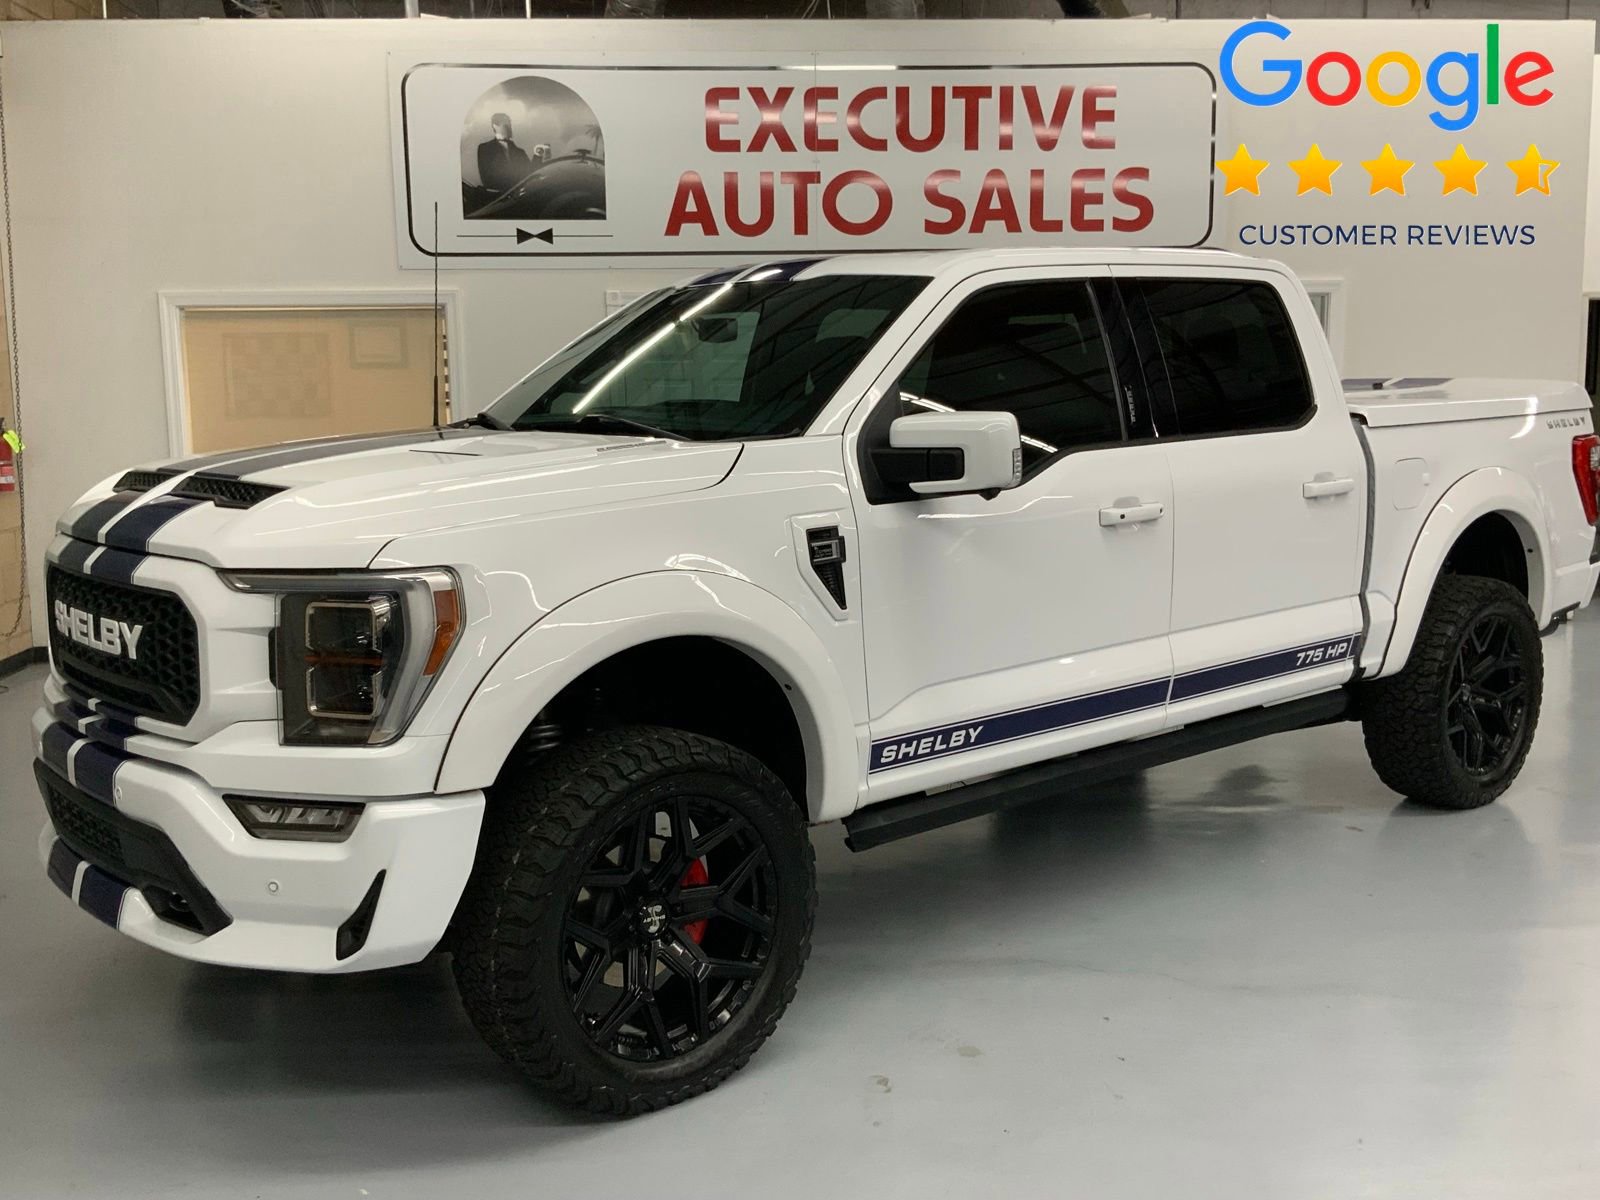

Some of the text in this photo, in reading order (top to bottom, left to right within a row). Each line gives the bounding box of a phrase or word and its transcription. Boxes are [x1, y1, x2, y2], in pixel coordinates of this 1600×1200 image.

[704, 86, 1118, 152] EXECUTIVE
[664, 167, 1154, 237] AUTO SALES
[54, 599, 143, 660] SHELBY
[1296, 642, 1348, 666] 775 HP
[880, 725, 984, 763] SHELBY
